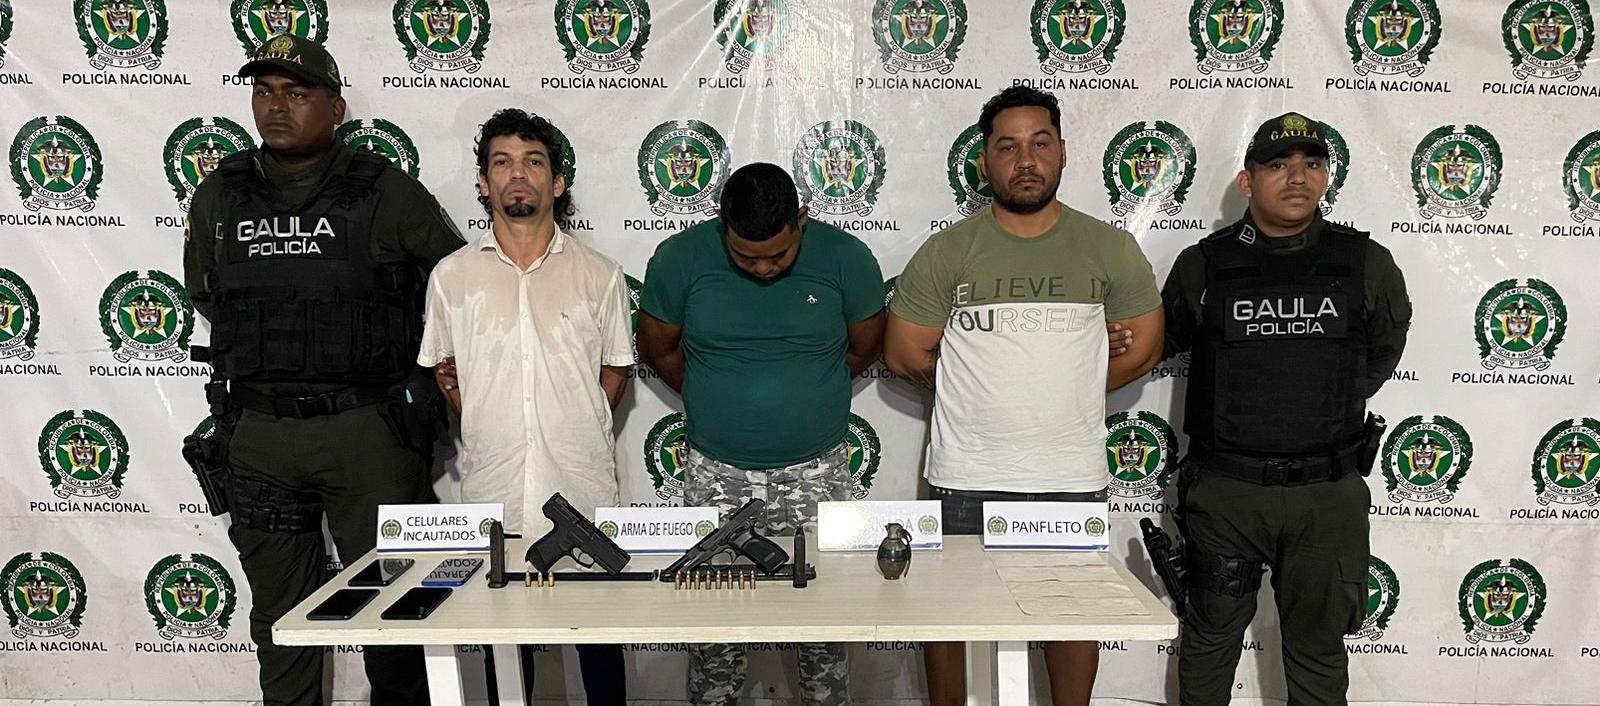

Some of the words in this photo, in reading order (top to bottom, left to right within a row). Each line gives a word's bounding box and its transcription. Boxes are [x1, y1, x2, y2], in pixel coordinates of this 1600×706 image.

[0, 74, 32, 85] ONAL
[63, 71, 117, 85] POLICÍA
[121, 74, 191, 86] NACIONAL
[383, 76, 437, 88] POLICÍA
[441, 77, 510, 88] NACIONAL
[541, 75, 595, 88] POLICÍA
[599, 77, 668, 88] NACIONAL
[913, 78, 982, 89] NACIONAL
[1012, 76, 1065, 89] POLICÍA
[1070, 79, 1139, 89] NACIONAL
[1170, 77, 1222, 89] POLICÍA
[1227, 77, 1293, 88] NACIONAL
[1326, 77, 1376, 90] POLICÍA
[1381, 81, 1451, 92] NACIONAL
[1483, 79, 1535, 94] POLICÍA
[1539, 84, 1600, 97] NACIONA
[1270, 130, 1318, 141] GAULA
[0, 211, 51, 225] POLICÍA
[56, 216, 125, 226] NACIONAL
[155, 217, 186, 229] POLI
[624, 217, 675, 230] POLICÍA
[1150, 219, 1206, 230] ACIONAL
[237, 216, 335, 241] GAULA
[833, 220, 900, 231] NACIONAL
[1391, 220, 1441, 233] POLICÍA
[1446, 223, 1512, 235] NACIONAL
[1543, 221, 1594, 237] POLICÍA
[248, 238, 322, 257] POLICÍA
[1233, 297, 1339, 320] GAULA
[950, 307, 1085, 333] YOURSEL
[1246, 318, 1325, 336] POLICÍA
[89, 362, 142, 376] POLICÍA
[1152, 367, 1190, 378] POLIC
[1452, 368, 1504, 383] POLICÍA
[1509, 374, 1574, 385] NACIONAL
[30, 499, 81, 512] POLICÍA
[84, 502, 150, 512] NACIONAL
[180, 504, 208, 514] POLI
[1368, 502, 1411, 516] OLICÍA
[1414, 506, 1480, 518] NACIONAL
[1510, 505, 1558, 519] POLICÍA
[1562, 509, 1599, 519] NACIO
[407, 516, 468, 526] CELULARES
[1012, 521, 1082, 534] PANFLETO
[620, 523, 648, 536] ARMA
[648, 523, 661, 536] DE
[662, 522, 694, 536] FUEGO
[403, 531, 476, 541] INCAUTADOS
[0, 640, 39, 652] OLICÍA
[41, 641, 107, 651] NACIONAL
[136, 638, 185, 653] POLICÍA
[189, 641, 257, 653] NACIONAL
[631, 643, 688, 652] NACIONA
[1346, 644, 1408, 655] NACIONAL
[1439, 642, 1488, 656] POLICÍA
[1491, 647, 1554, 657] NACIONAL
